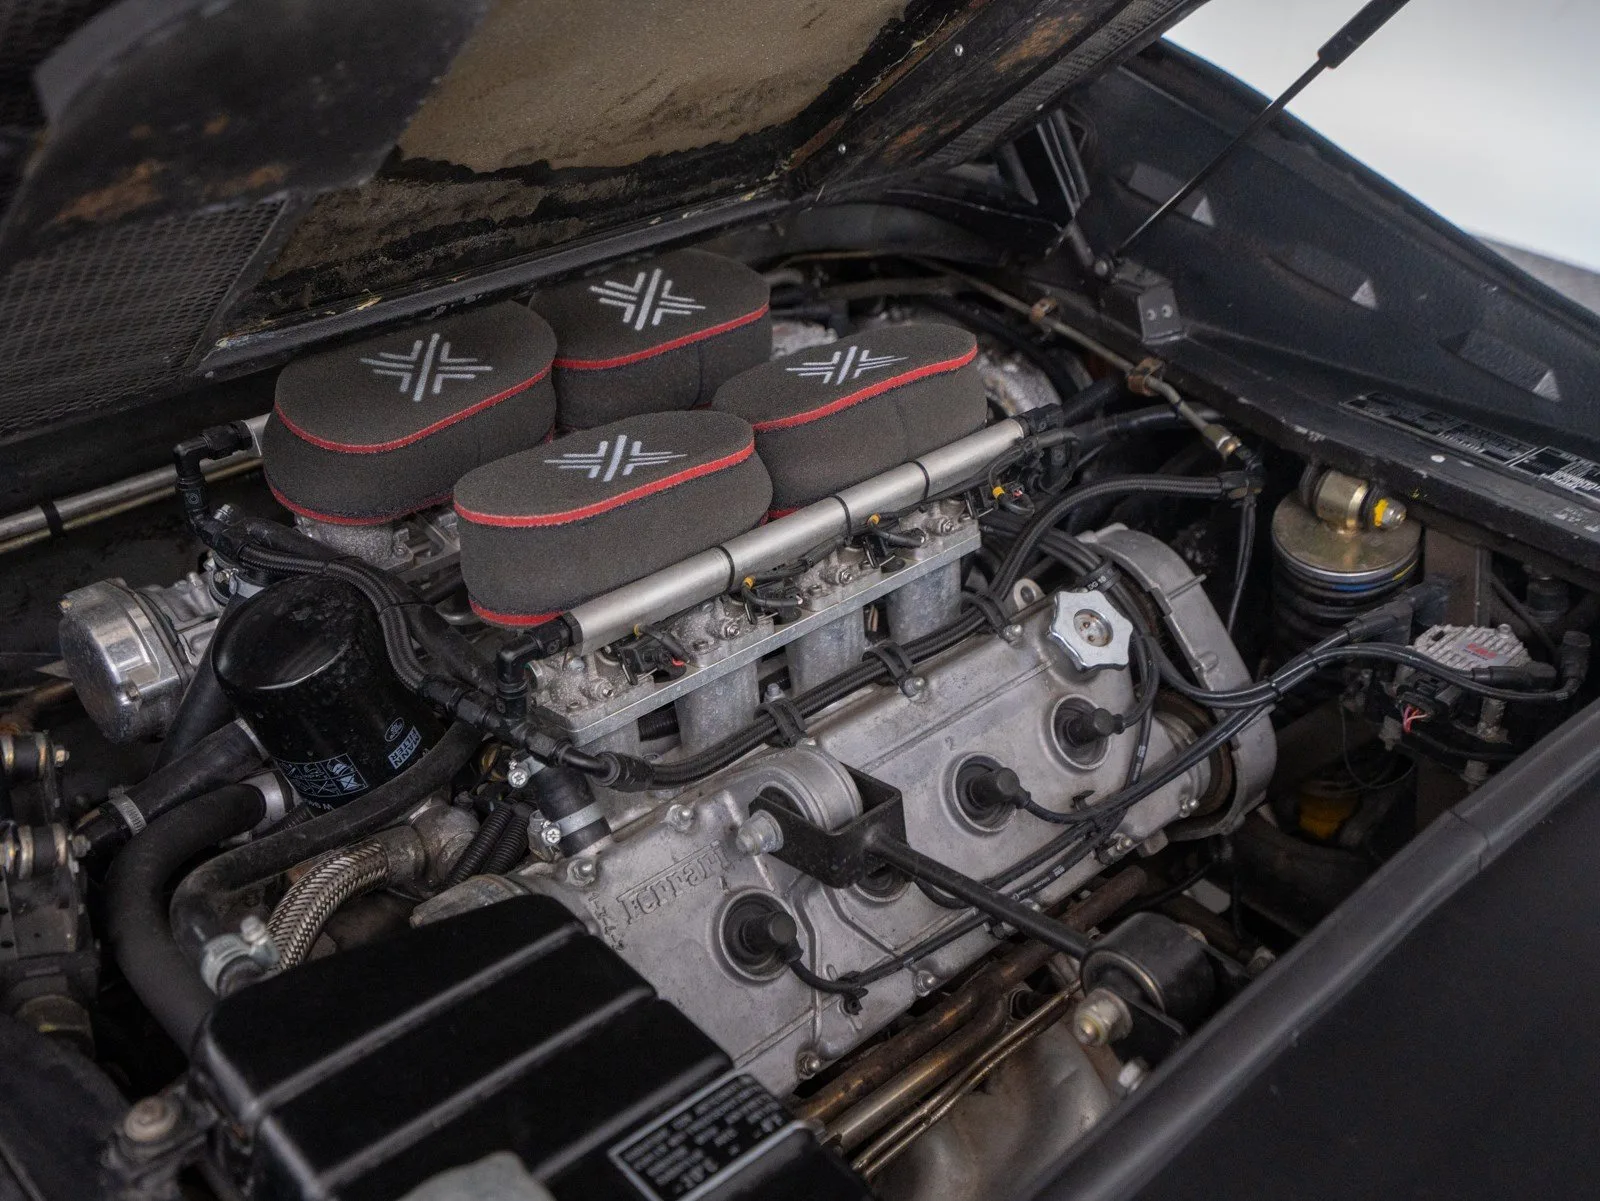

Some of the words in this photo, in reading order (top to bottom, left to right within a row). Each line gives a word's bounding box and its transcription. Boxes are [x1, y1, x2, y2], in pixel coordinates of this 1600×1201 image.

[390, 728, 415, 760] FILTER
[394, 731, 420, 766] MANN
[616, 839, 732, 925] Ferrari
